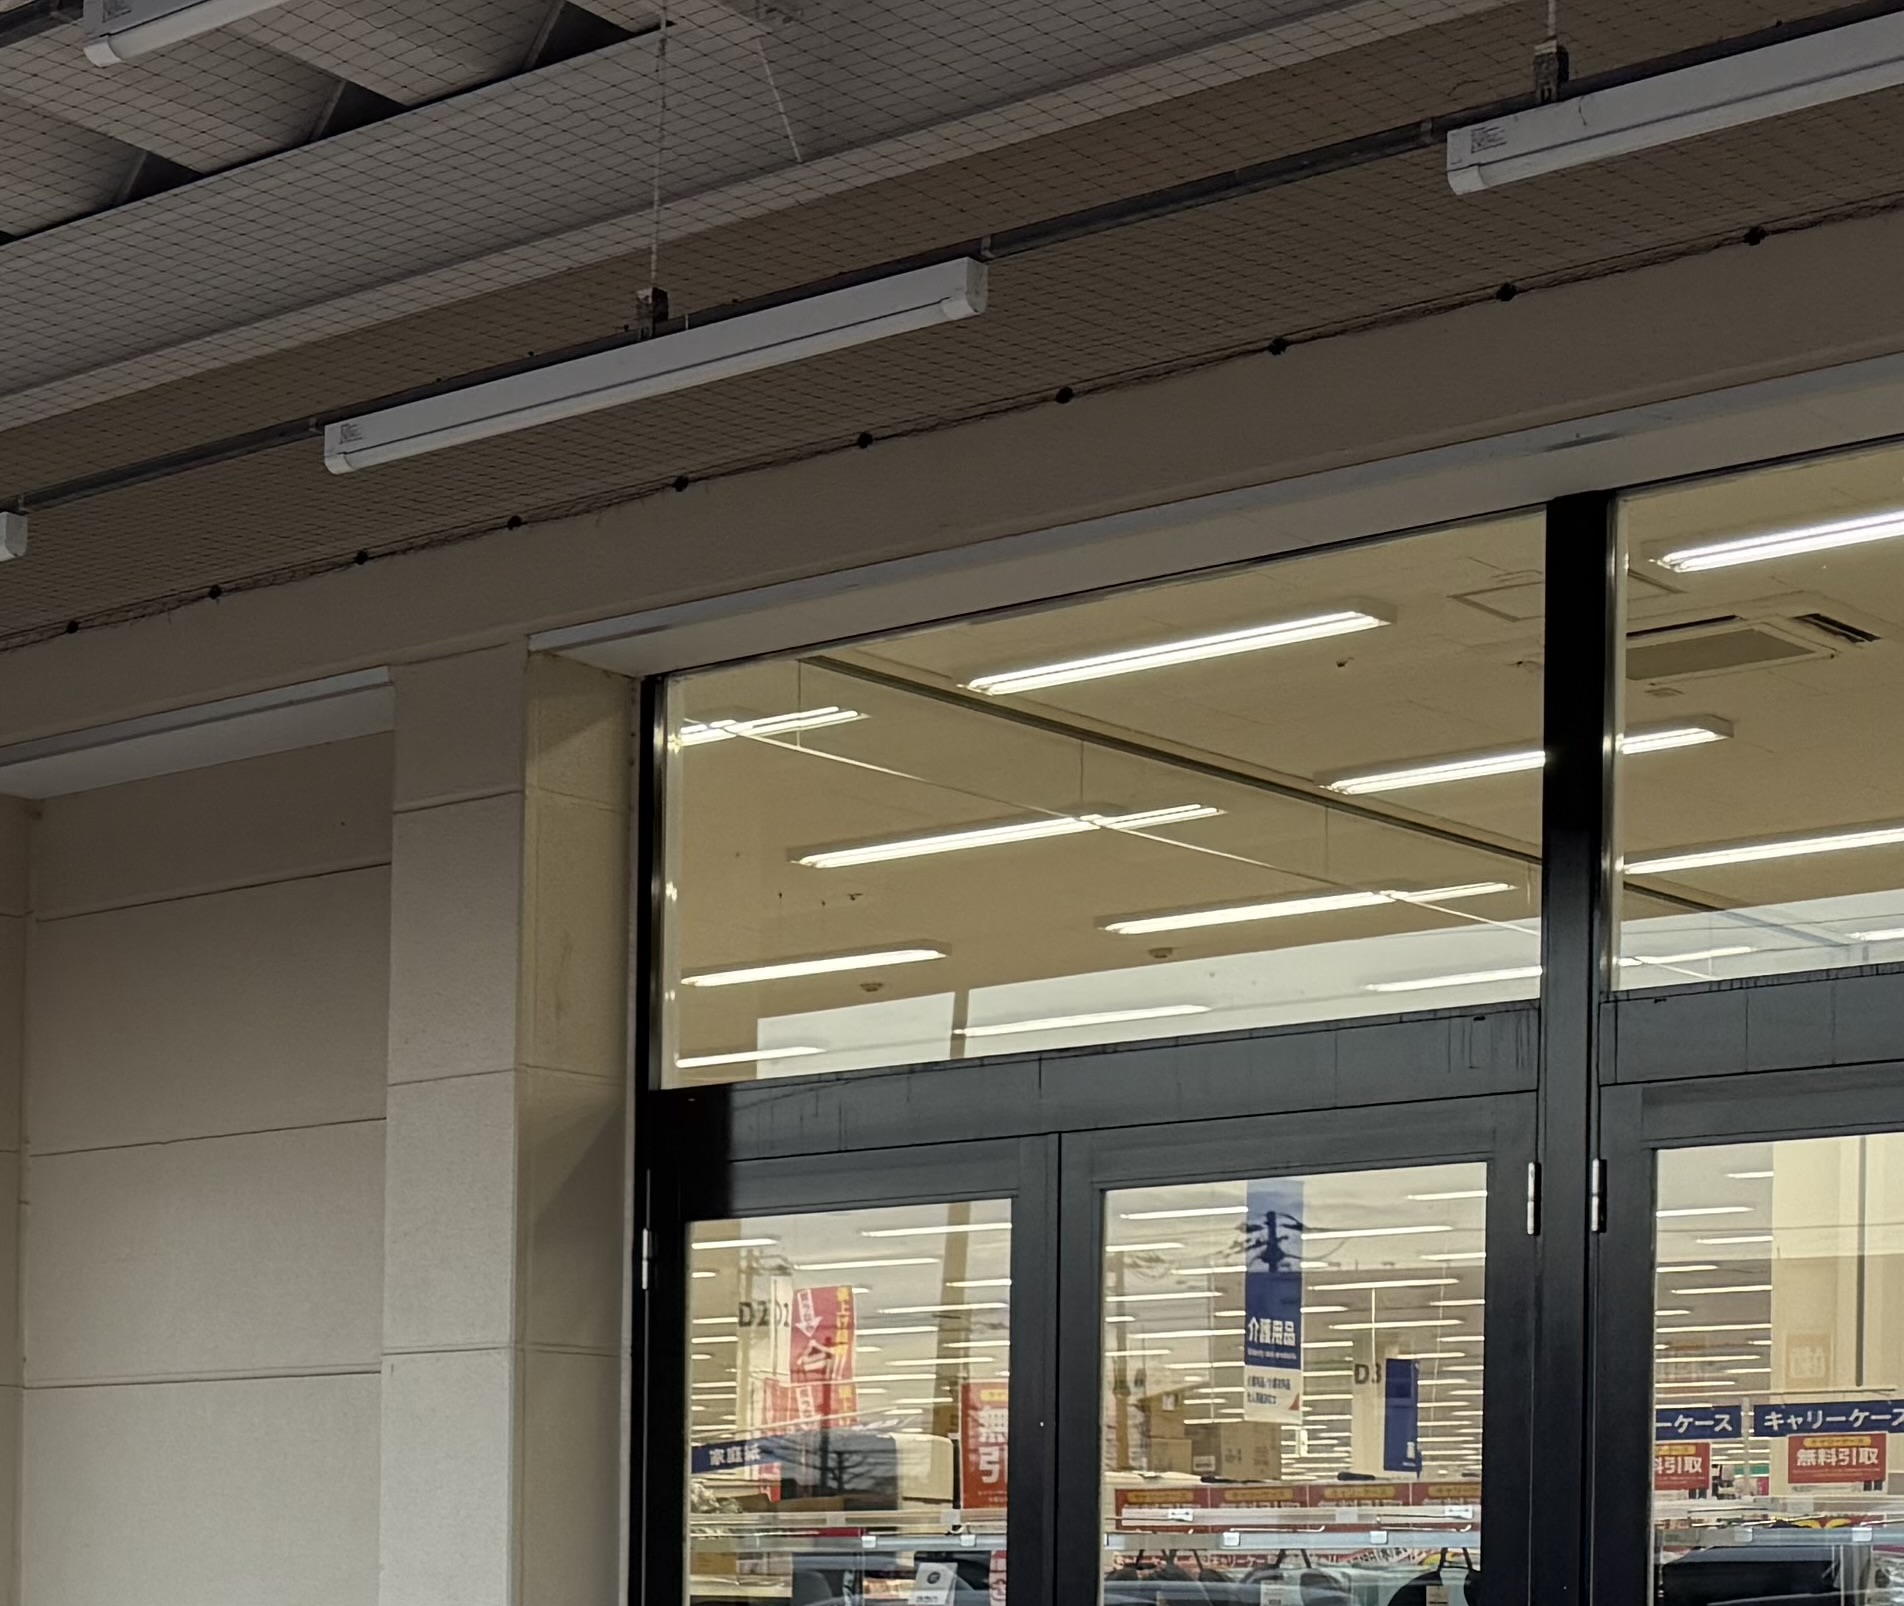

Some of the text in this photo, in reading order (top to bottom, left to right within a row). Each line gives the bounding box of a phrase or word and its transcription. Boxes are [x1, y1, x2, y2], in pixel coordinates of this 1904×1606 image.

[738, 1301, 770, 1327] D2
[1248, 1316, 1296, 1347] 介護用品
[1764, 1408, 1904, 1431] キャリーケース
[1796, 1448, 1880, 1467] 無料引取
